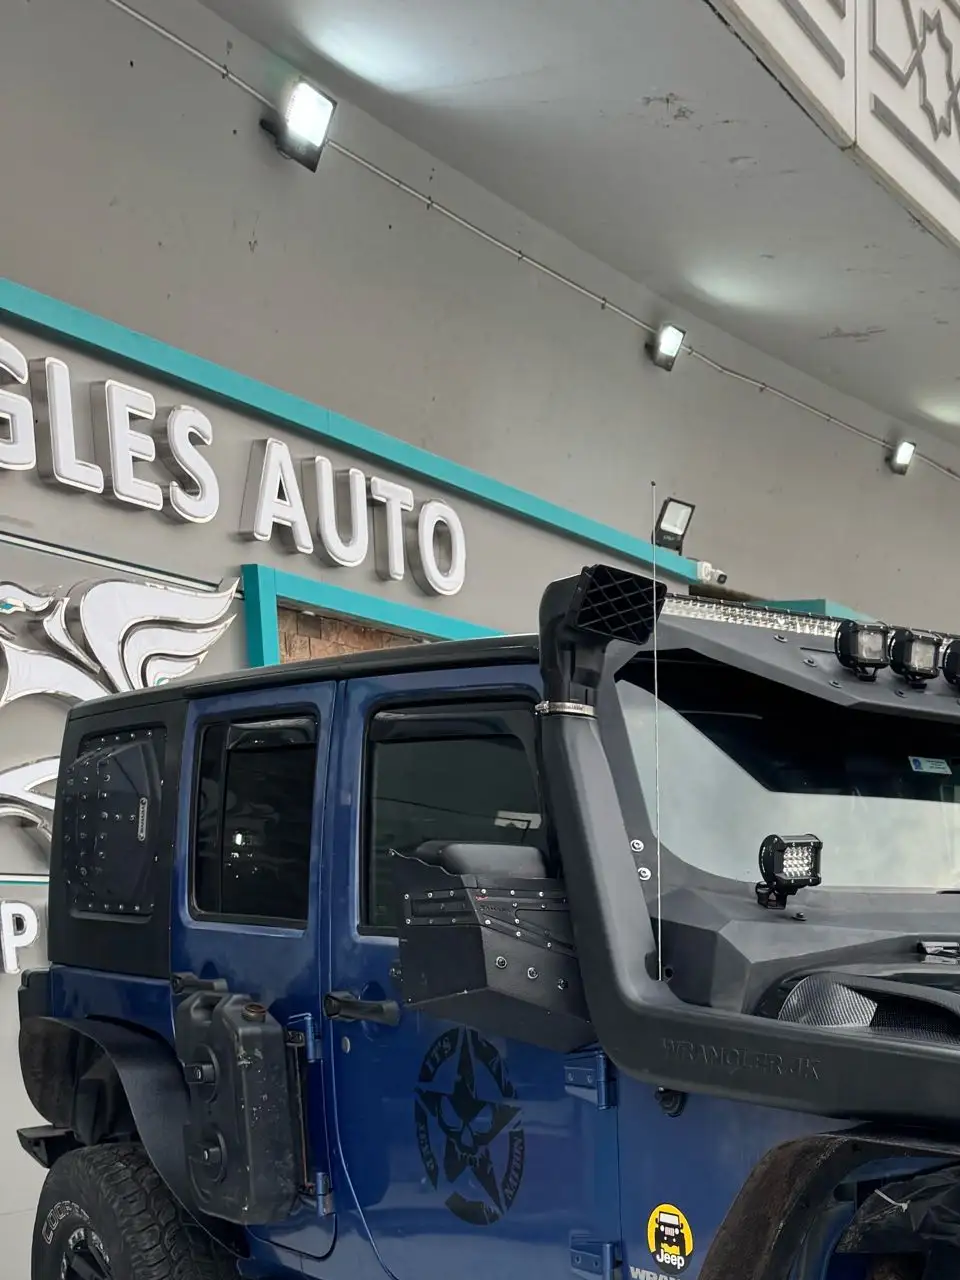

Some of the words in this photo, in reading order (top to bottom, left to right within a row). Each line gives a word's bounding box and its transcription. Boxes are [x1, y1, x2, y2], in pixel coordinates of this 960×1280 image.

[251, 437, 467, 597] AUTO
[659, 1037, 784, 1076] WRANGLER
[656, 1248, 685, 1270] Jeep
